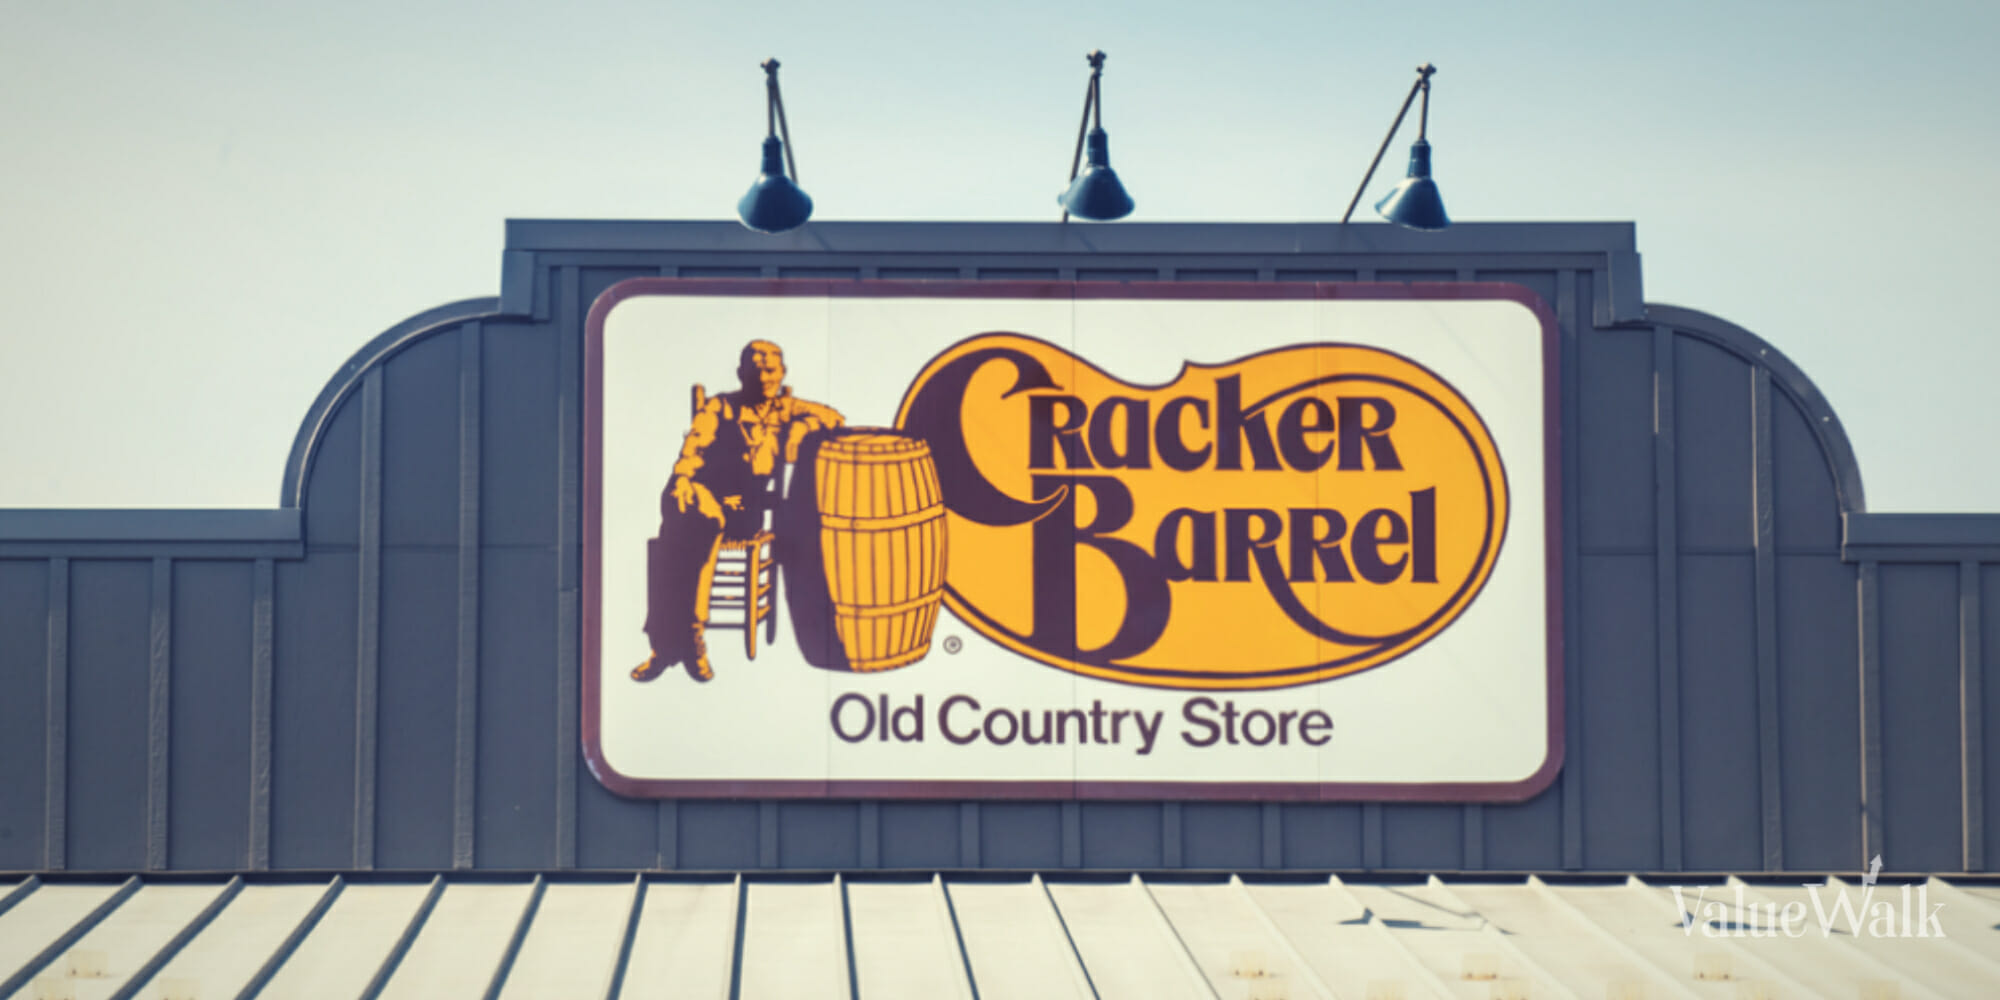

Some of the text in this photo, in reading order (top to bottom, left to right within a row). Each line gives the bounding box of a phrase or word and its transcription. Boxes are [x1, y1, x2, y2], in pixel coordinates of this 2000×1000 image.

[902, 347, 1404, 527] Cracker
[1031, 474, 1439, 664] Barrel
[830, 692, 1334, 755] Old Country Store
